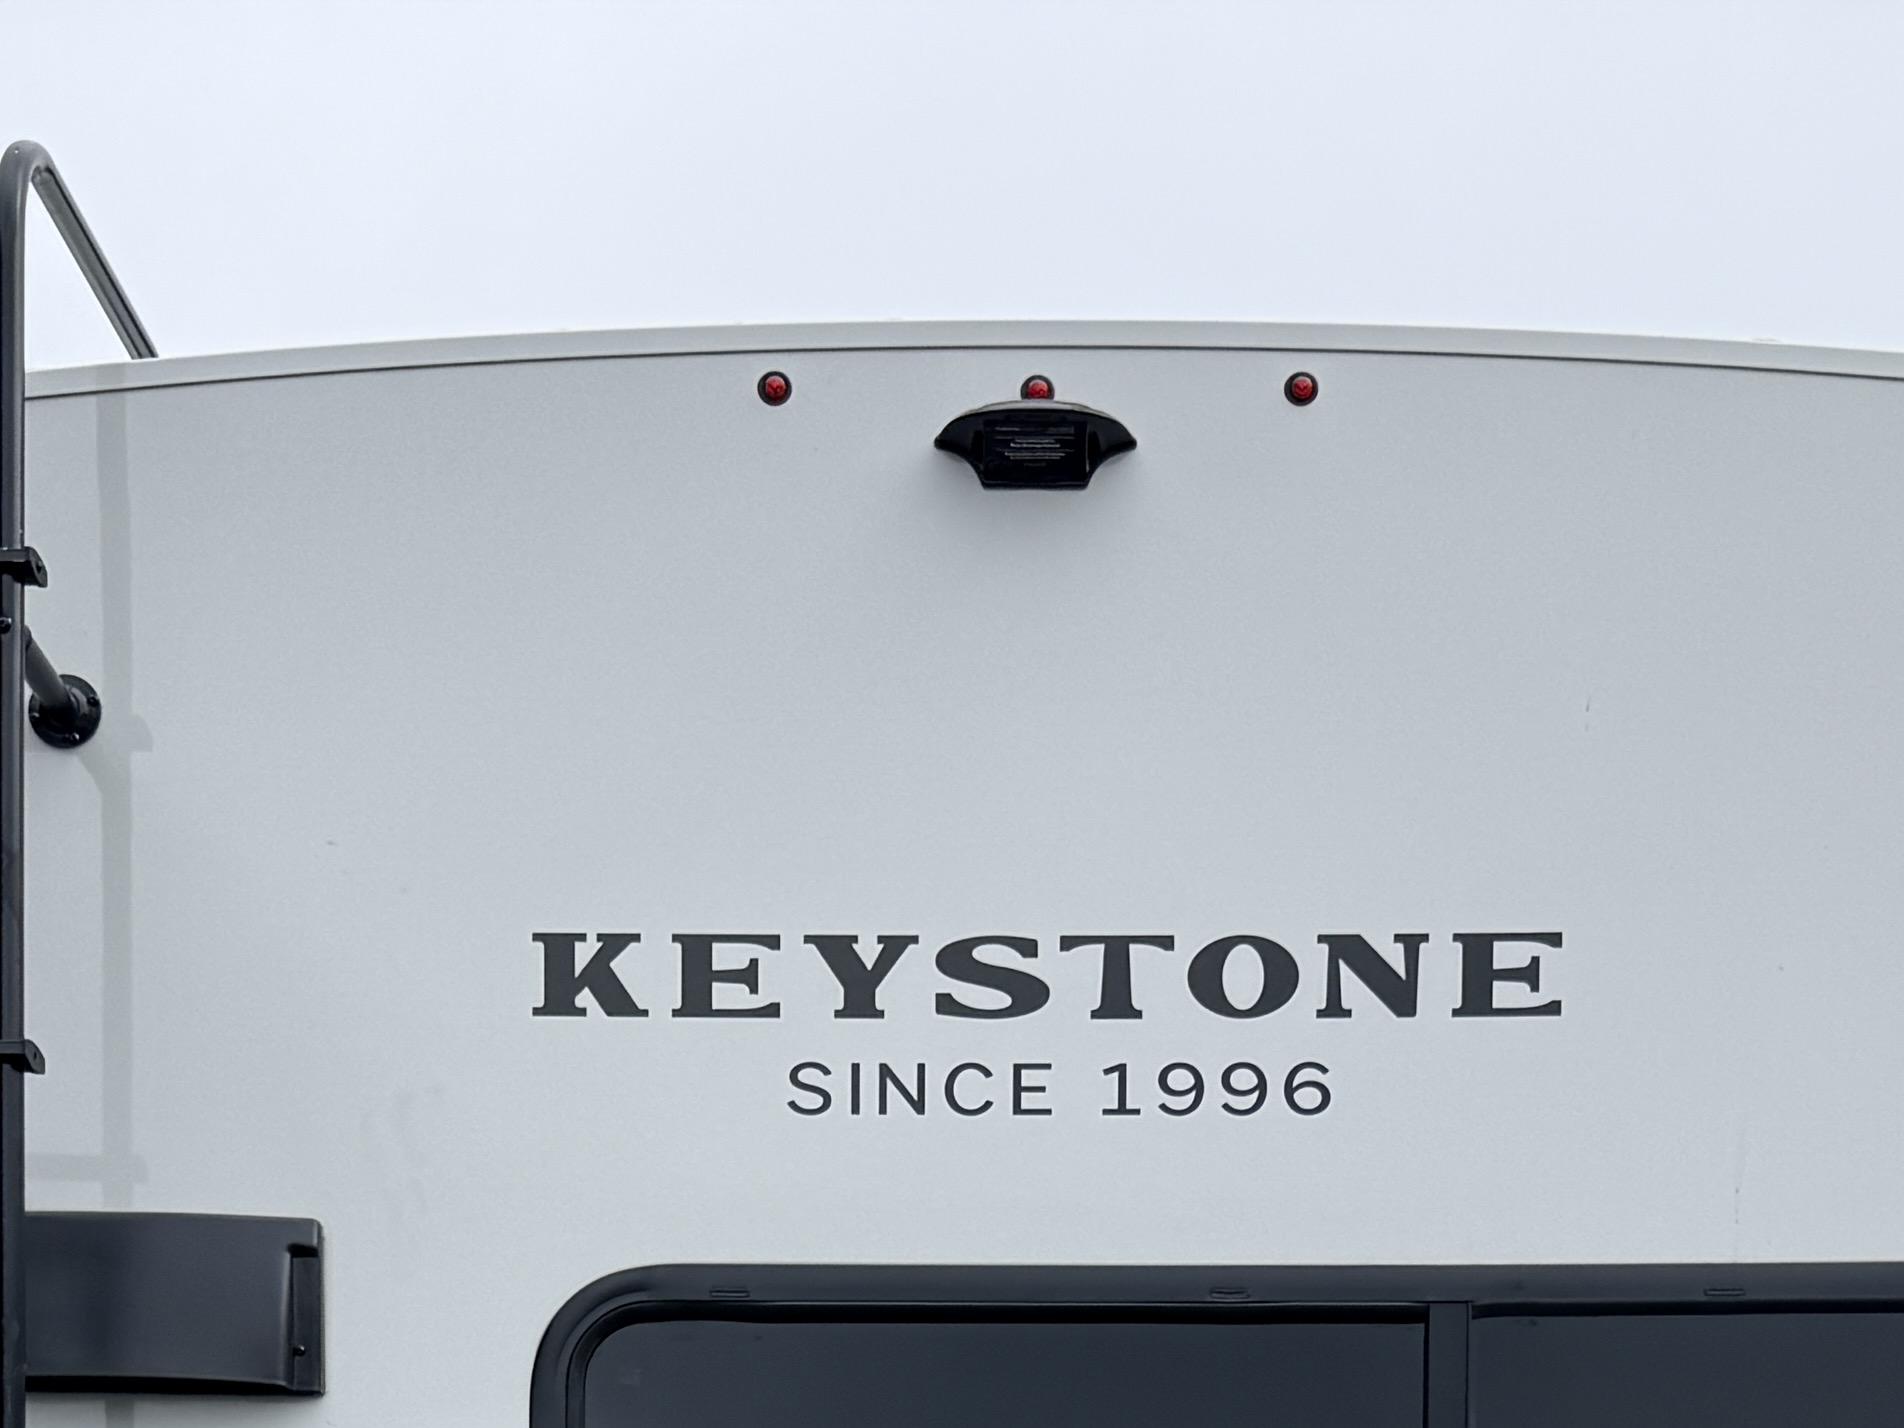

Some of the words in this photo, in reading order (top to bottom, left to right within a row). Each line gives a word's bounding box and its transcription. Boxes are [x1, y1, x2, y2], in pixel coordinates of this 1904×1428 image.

[532, 932, 1562, 1019] KEYSTONE
[788, 1062, 1052, 1116] SINCE
[1102, 1062, 1331, 1116] 1996
